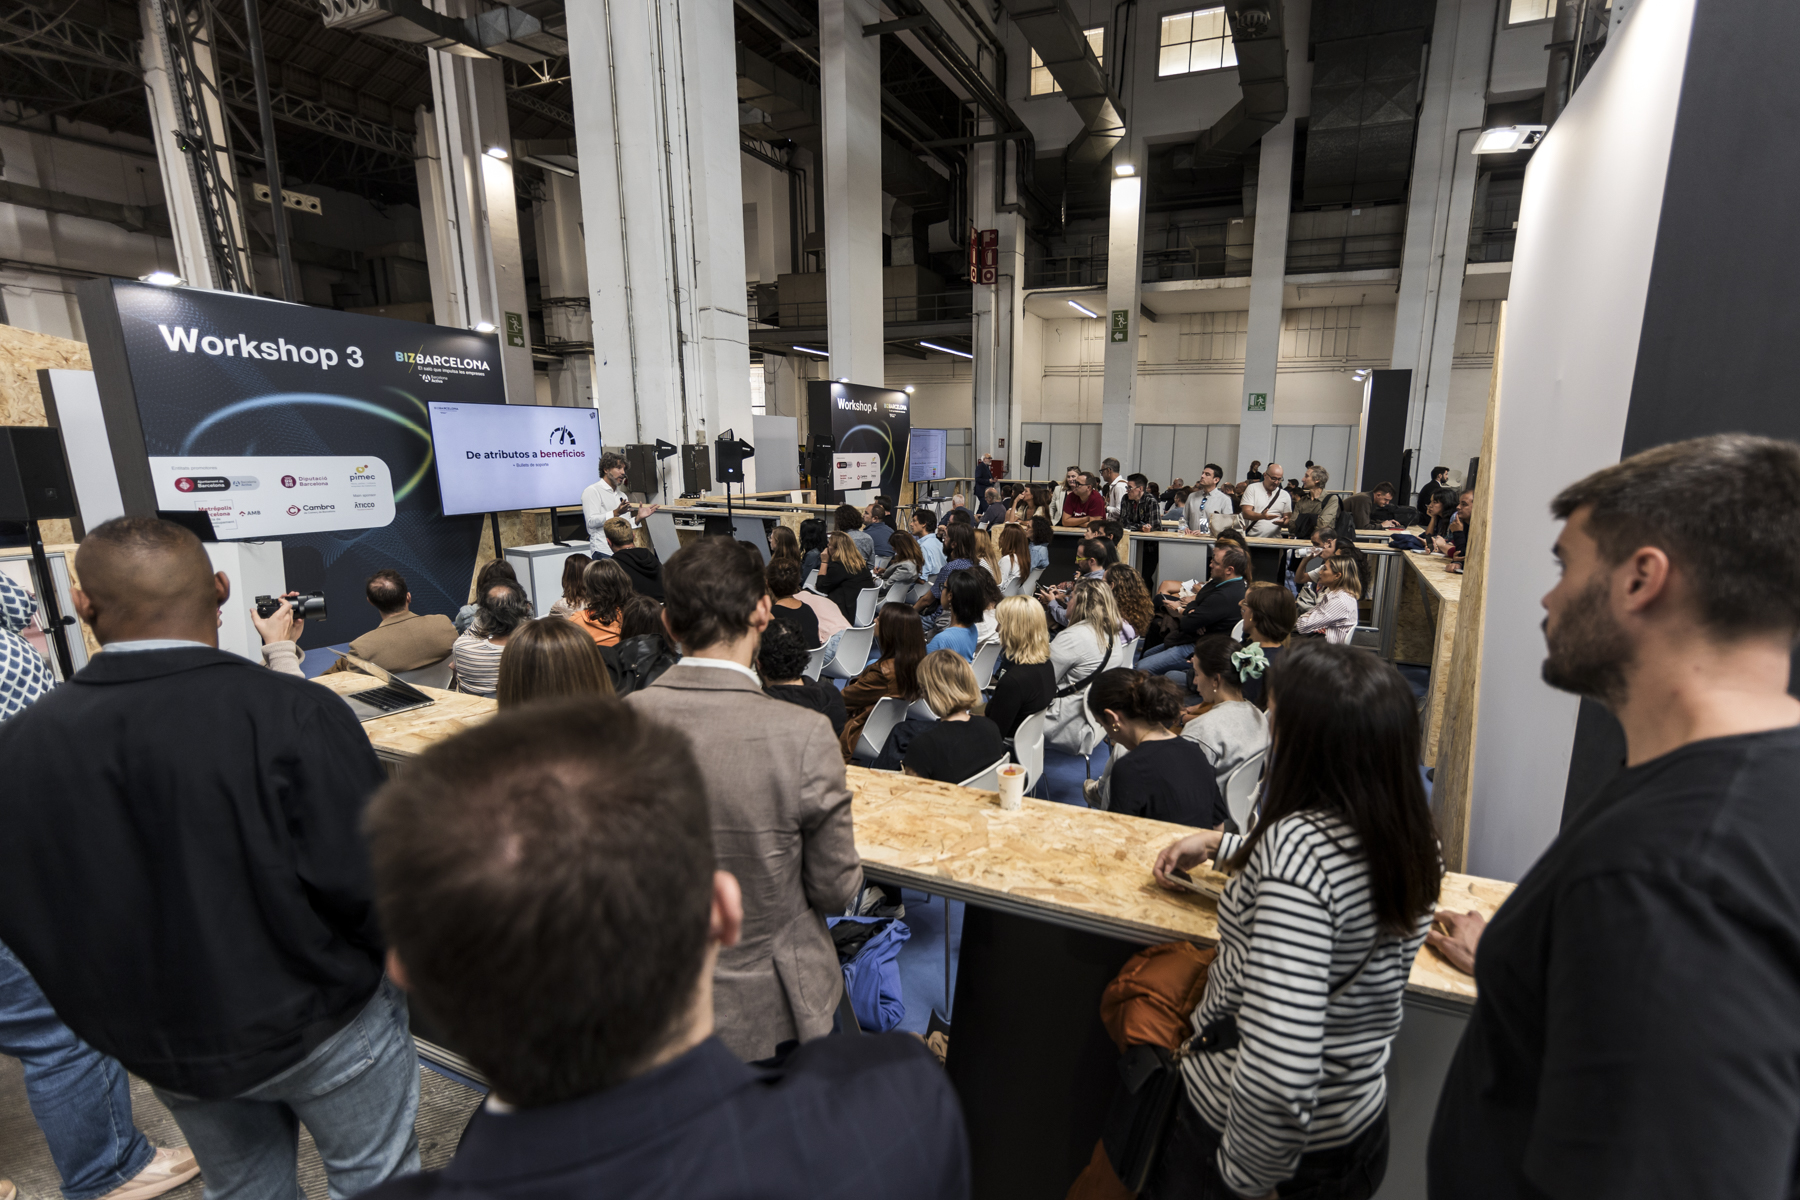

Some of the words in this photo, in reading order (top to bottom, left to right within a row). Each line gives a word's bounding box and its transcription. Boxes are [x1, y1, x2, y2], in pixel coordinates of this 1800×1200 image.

[158, 324, 338, 370] Workshop
[346, 346, 364, 368] 3
[394, 350, 490, 371] BIZBARCELONA
[837, 398, 872, 414] Workshop
[873, 402, 878, 412] 4
[466, 450, 481, 460] De
[484, 450, 530, 459] atributos
[540, 449, 586, 458] beneficios
[350, 472, 375, 482] pimec
